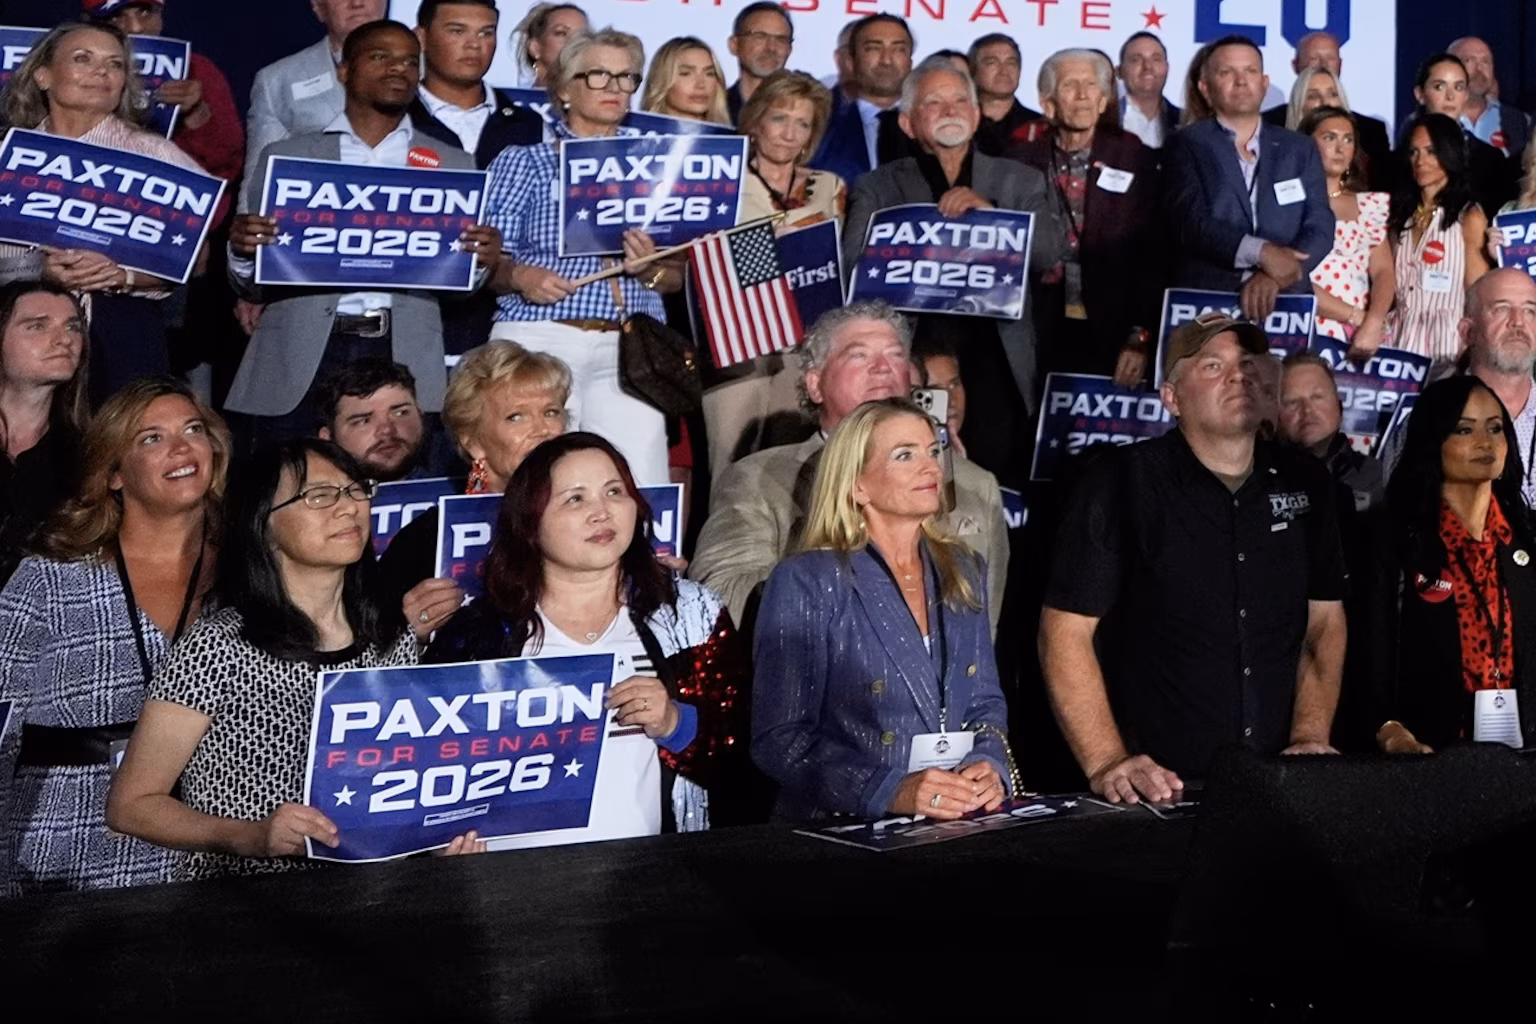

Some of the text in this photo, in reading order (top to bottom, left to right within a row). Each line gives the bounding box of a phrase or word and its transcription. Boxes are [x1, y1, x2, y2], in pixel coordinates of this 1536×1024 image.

[6, 147, 212, 216] PAXTON
[569, 155, 741, 184] PAXTON
[275, 178, 479, 215] PAXTON
[596, 196, 712, 226] 2026
[20, 191, 167, 245] 2026
[868, 221, 1026, 252] PAXTON
[301, 227, 442, 258] 2026
[885, 259, 996, 289] 2026
[329, 682, 606, 744] PAXTON
[326, 725, 599, 770] FOR SENATE
[368, 752, 555, 814] 2026
